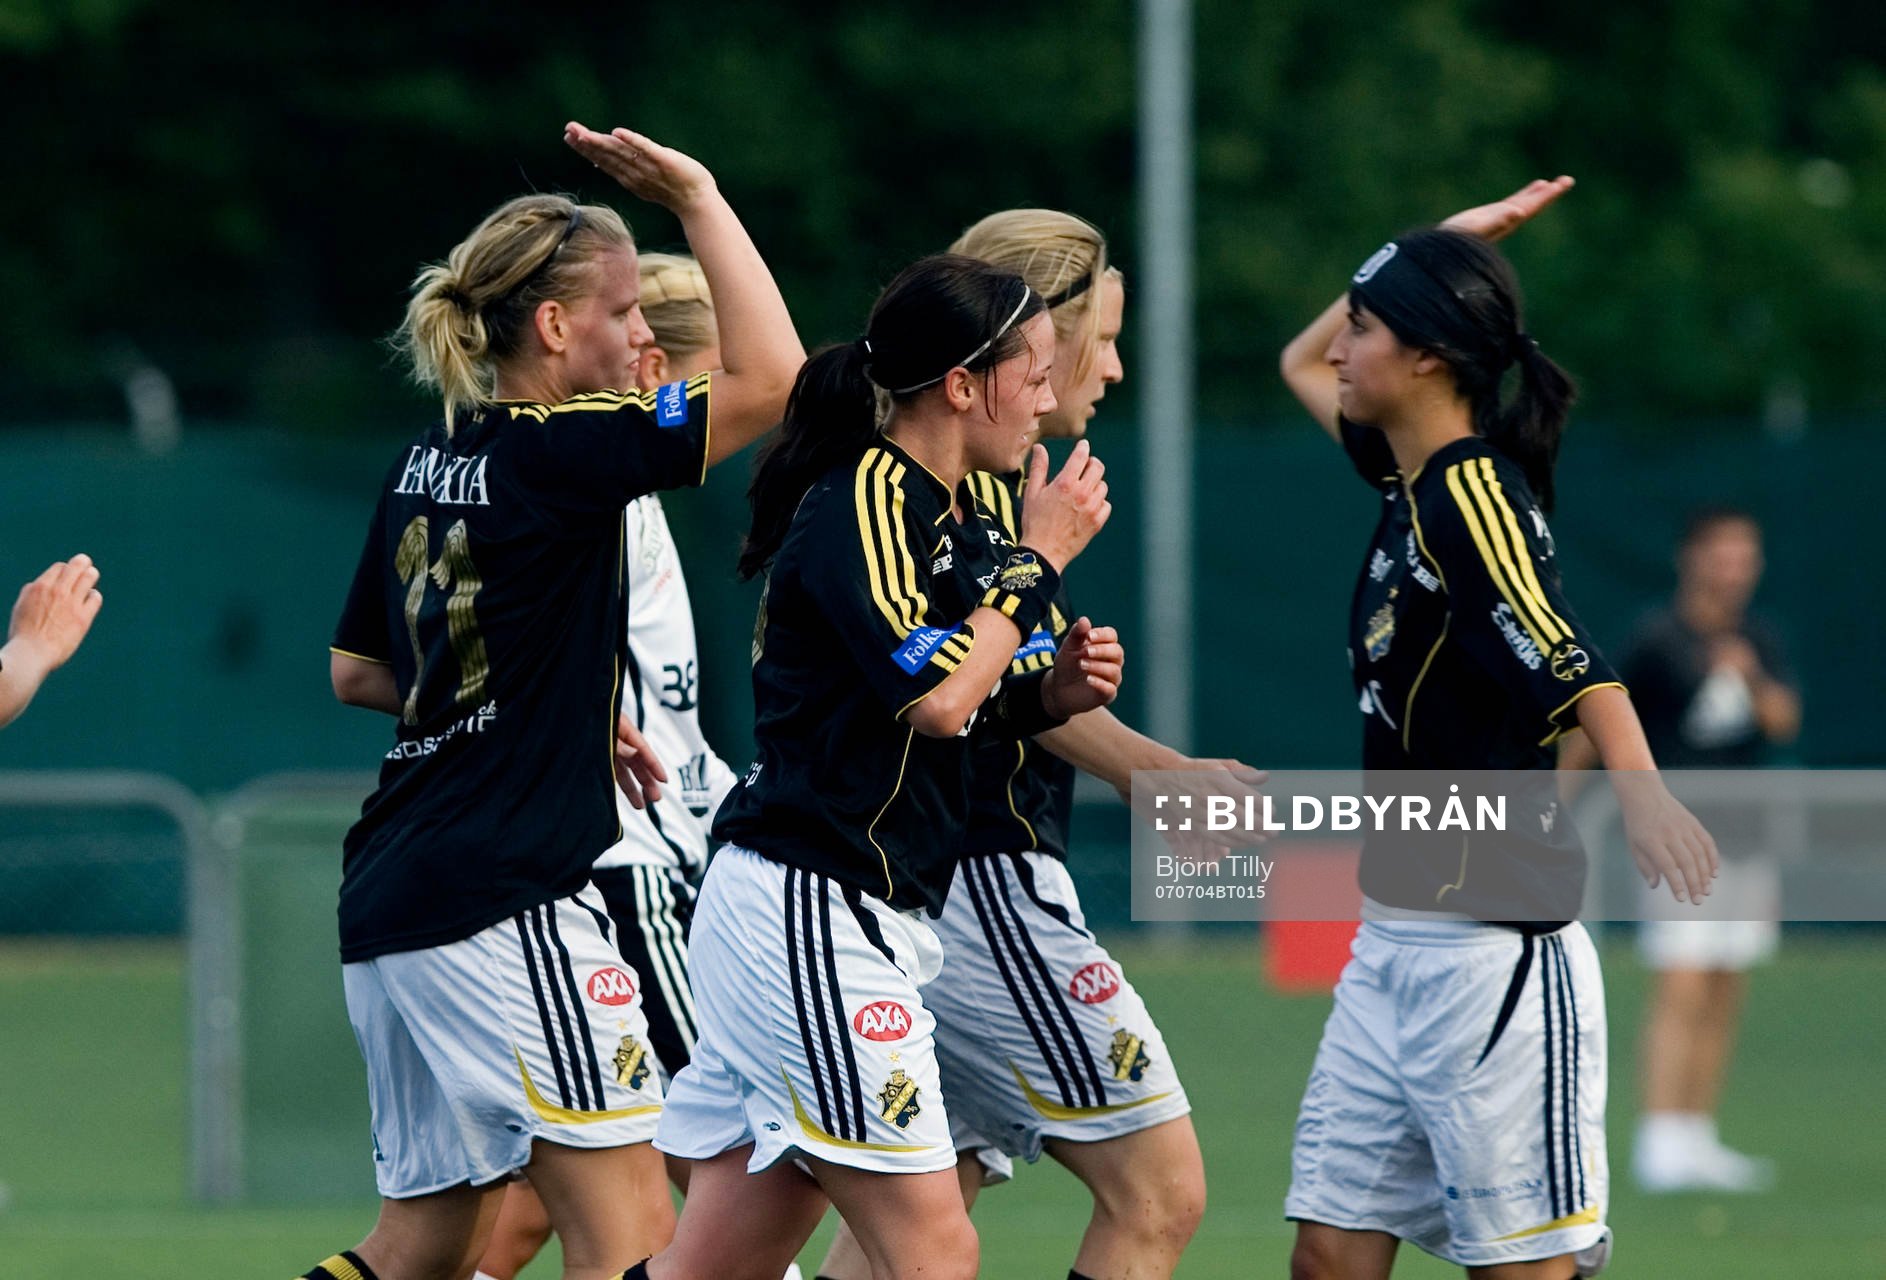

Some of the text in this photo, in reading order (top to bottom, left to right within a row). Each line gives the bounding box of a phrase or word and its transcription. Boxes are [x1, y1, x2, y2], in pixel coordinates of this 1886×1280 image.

[395, 515, 490, 726] 11
[592, 970, 634, 1001] AXA
[1077, 964, 1119, 1002] AXA
[860, 1004, 909, 1035] AXA
